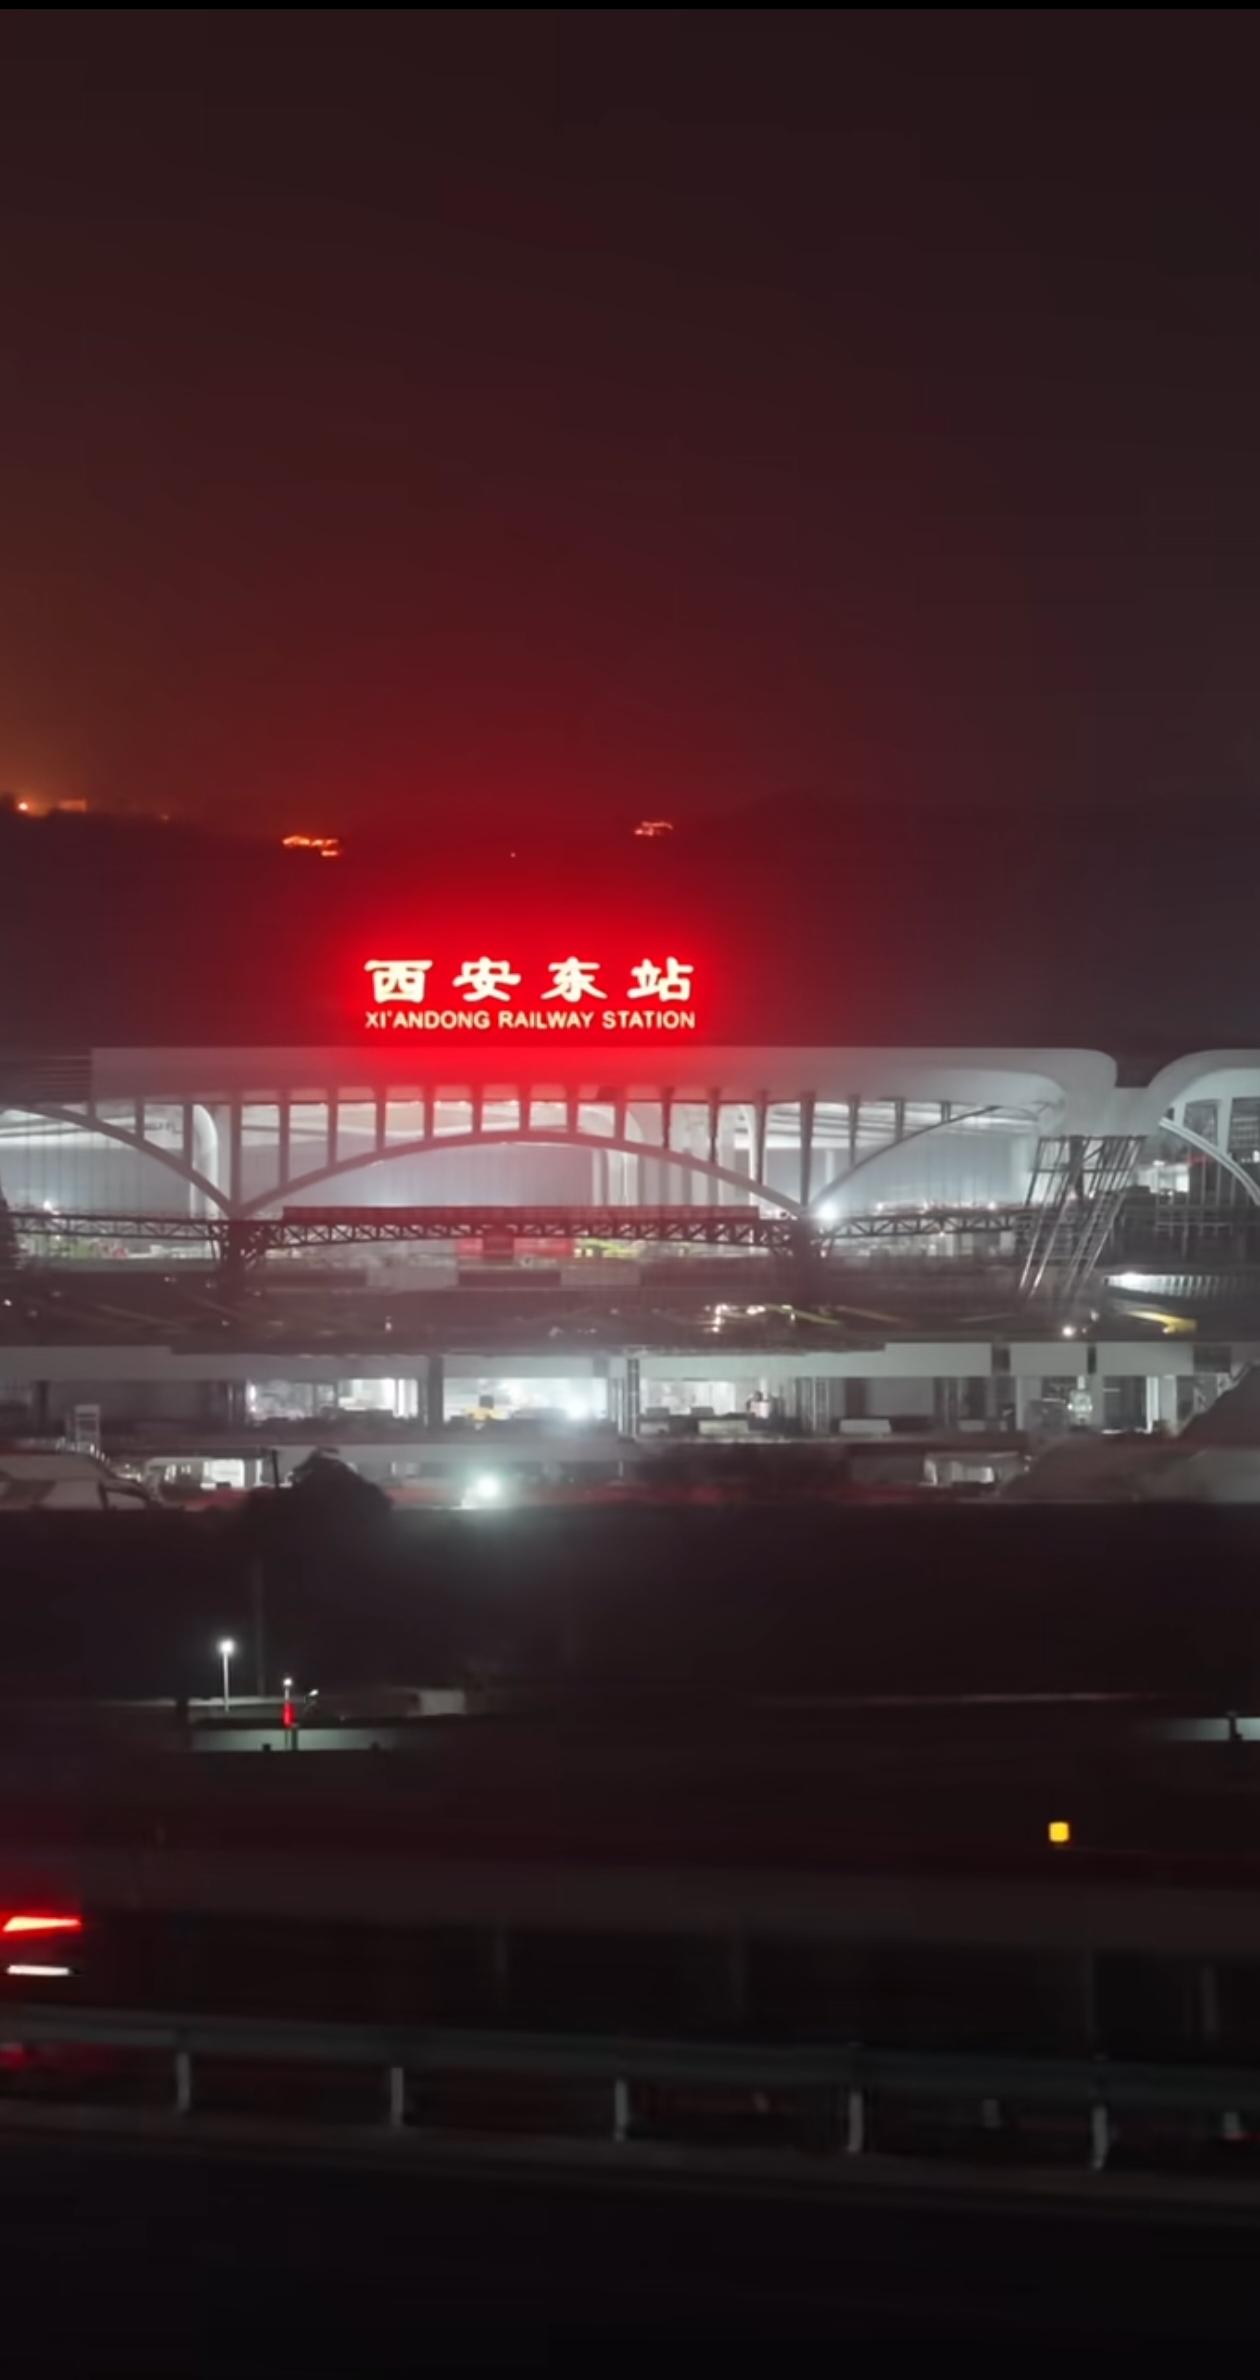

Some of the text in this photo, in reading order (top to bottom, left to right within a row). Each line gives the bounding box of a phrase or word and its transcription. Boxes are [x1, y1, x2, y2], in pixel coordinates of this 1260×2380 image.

[364, 956, 694, 1003] 西安东站
[365, 1010, 696, 1029] XI'ANDONG RAILWAY STATION
